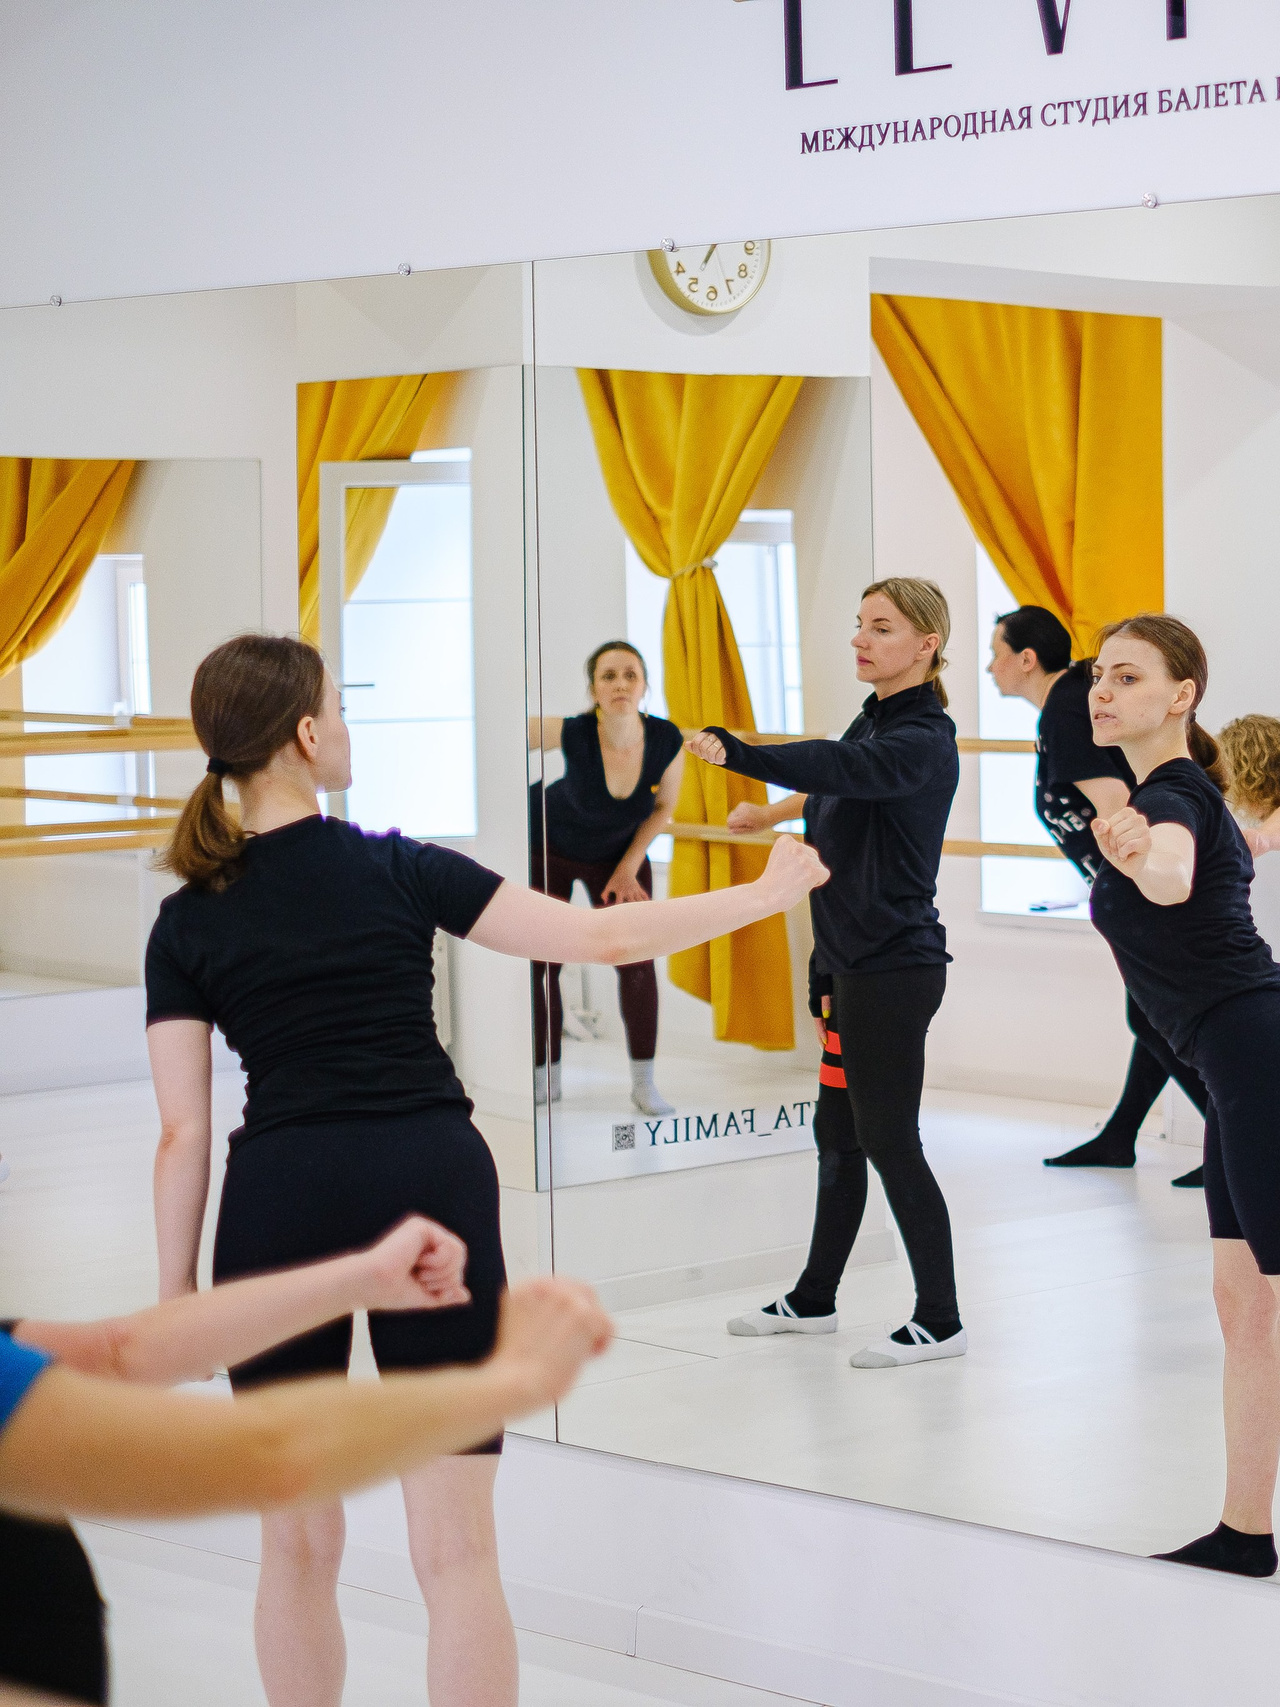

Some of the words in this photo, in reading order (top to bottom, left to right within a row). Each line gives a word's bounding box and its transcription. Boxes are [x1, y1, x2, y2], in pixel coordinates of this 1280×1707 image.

[800, 106, 1033, 154] МЕЖДУНАРОДНАЯ
[1040, 92, 1149, 127] СТУДИЯ
[1157, 79, 1267, 114] БАЛЕТА
